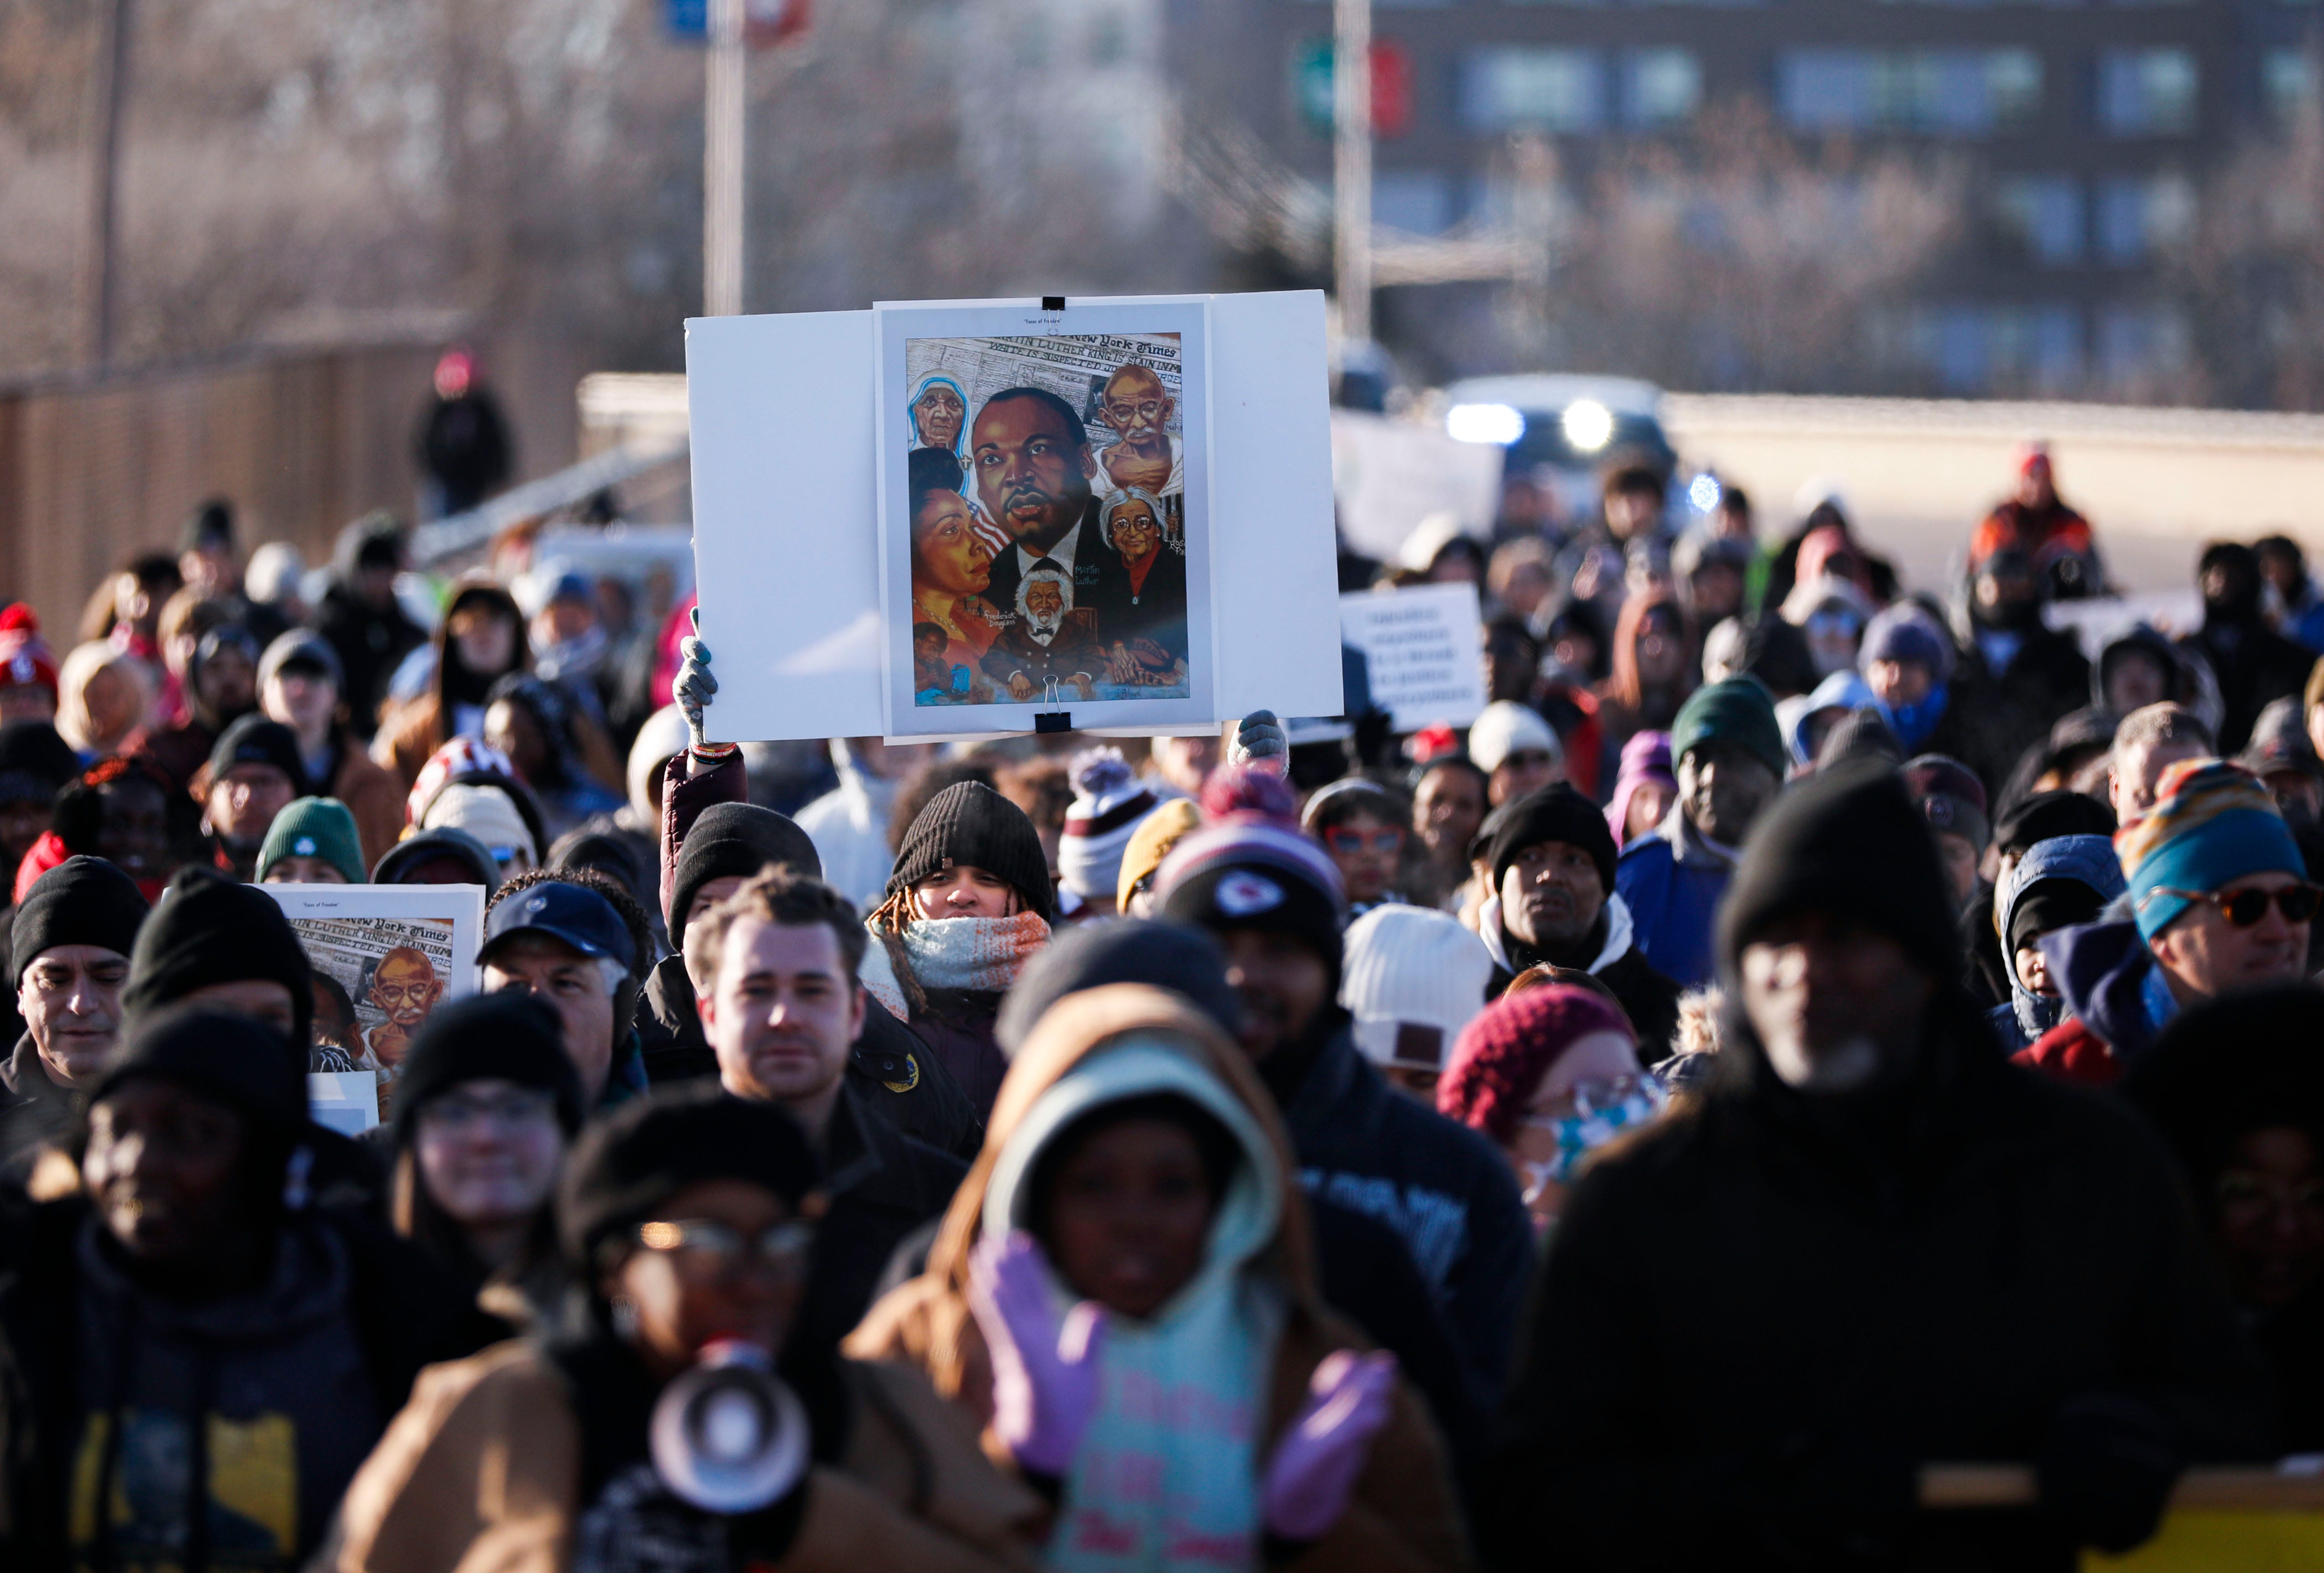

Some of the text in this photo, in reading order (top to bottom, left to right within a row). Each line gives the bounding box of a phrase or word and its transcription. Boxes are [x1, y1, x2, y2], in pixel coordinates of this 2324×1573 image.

[1038, 339, 1085, 356] LUTHER
[1087, 349, 1112, 361] KING
[1113, 354, 1124, 363] IS
[1128, 356, 1154, 369] SLAIN
[1100, 335, 1133, 350] York
[1137, 342, 1176, 357] Times
[1026, 348, 1039, 358] IS
[1041, 352, 1102, 370] SUSPECTED
[1167, 540, 1185, 550] Ros
[989, 619, 1016, 629] Douglass
[374, 918, 406, 932] York
[410, 925, 448, 942] Times
